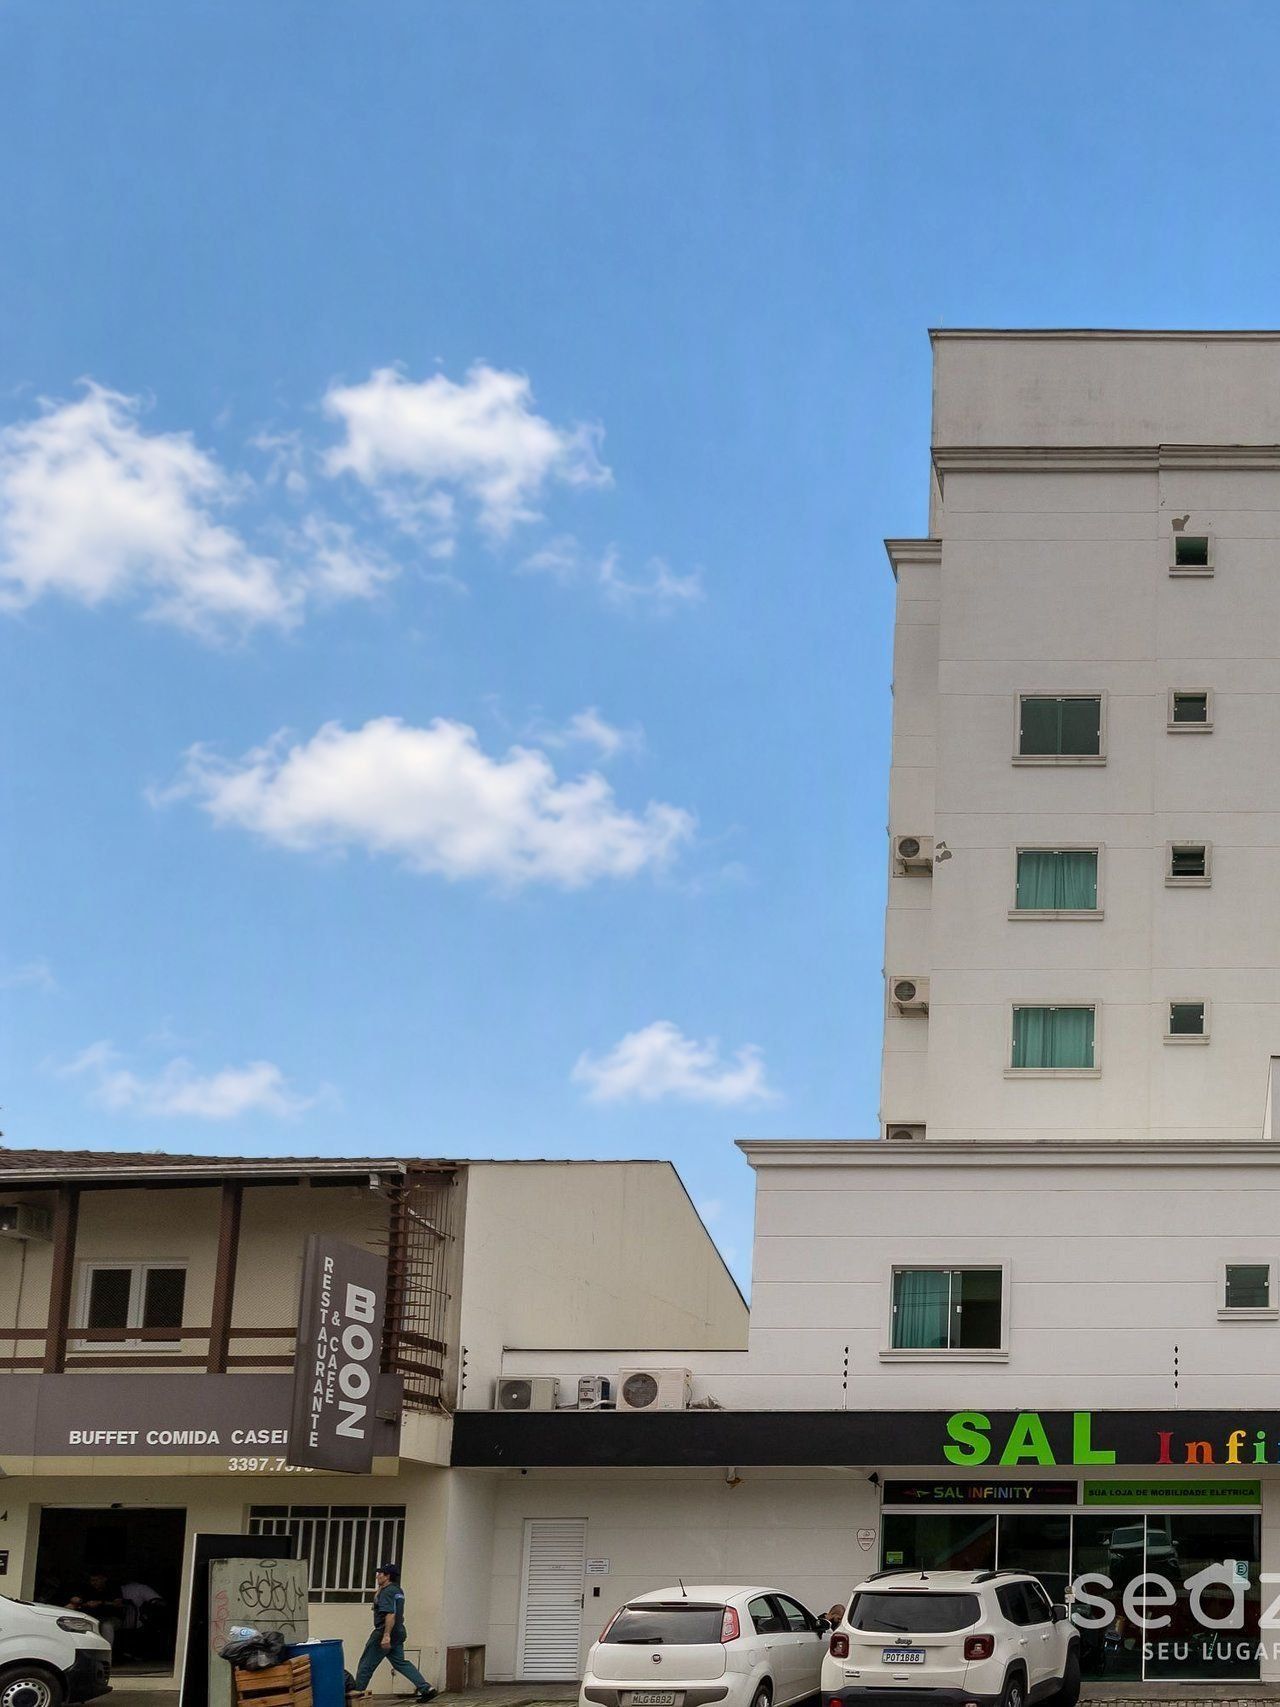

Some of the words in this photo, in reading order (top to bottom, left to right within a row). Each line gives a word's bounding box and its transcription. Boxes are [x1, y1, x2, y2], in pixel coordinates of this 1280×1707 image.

[331, 1310, 341, 1327] &
[308, 1256, 334, 1448] RESTAURANTE
[335, 1282, 376, 1440] BOOZ
[68, 1430, 139, 1445] BUFFET
[146, 1430, 220, 1445] COMIDA
[943, 1411, 1116, 1466] SAL
[228, 1457, 314, 1472] 3397.7
[933, 1487, 963, 1499] SAL
[967, 1487, 1033, 1499] INFINITY
[1088, 1488, 1107, 1497] SUA
[1109, 1488, 1133, 1497] LOJA
[1135, 1488, 1148, 1497] DE
[1150, 1488, 1207, 1497] MOBILIDADE
